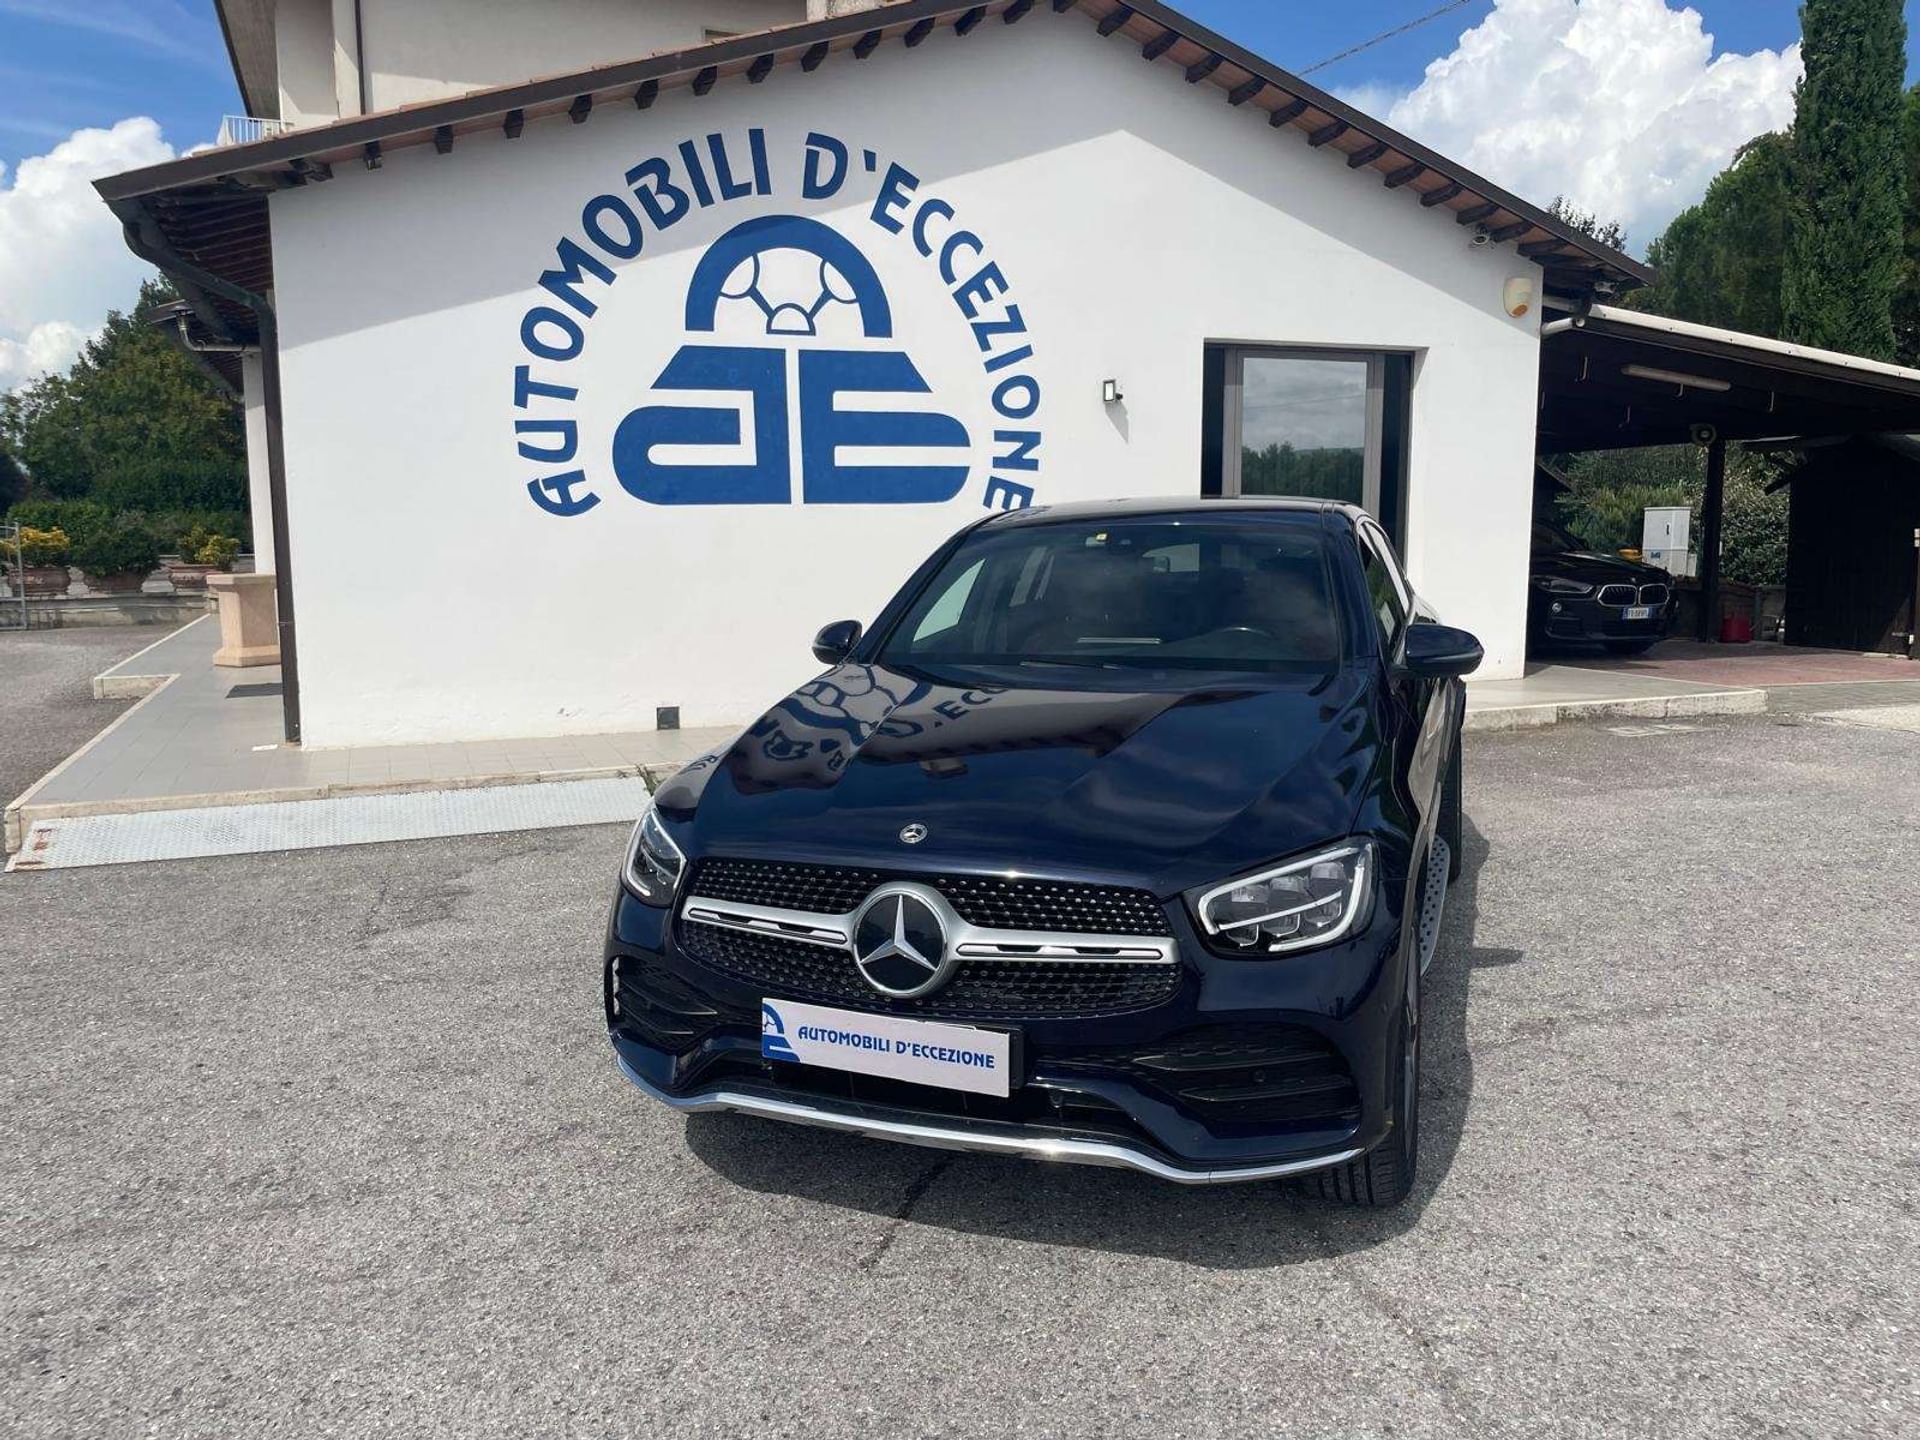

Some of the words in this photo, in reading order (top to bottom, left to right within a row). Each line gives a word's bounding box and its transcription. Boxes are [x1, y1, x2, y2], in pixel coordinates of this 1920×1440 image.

[514, 128, 772, 516] AUTOMOBILI
[803, 132, 1042, 511] D'ECCEZIONE
[798, 1026, 890, 1052] AUTOMOBILI
[896, 1041, 995, 1068] D'ECCEZIONE
